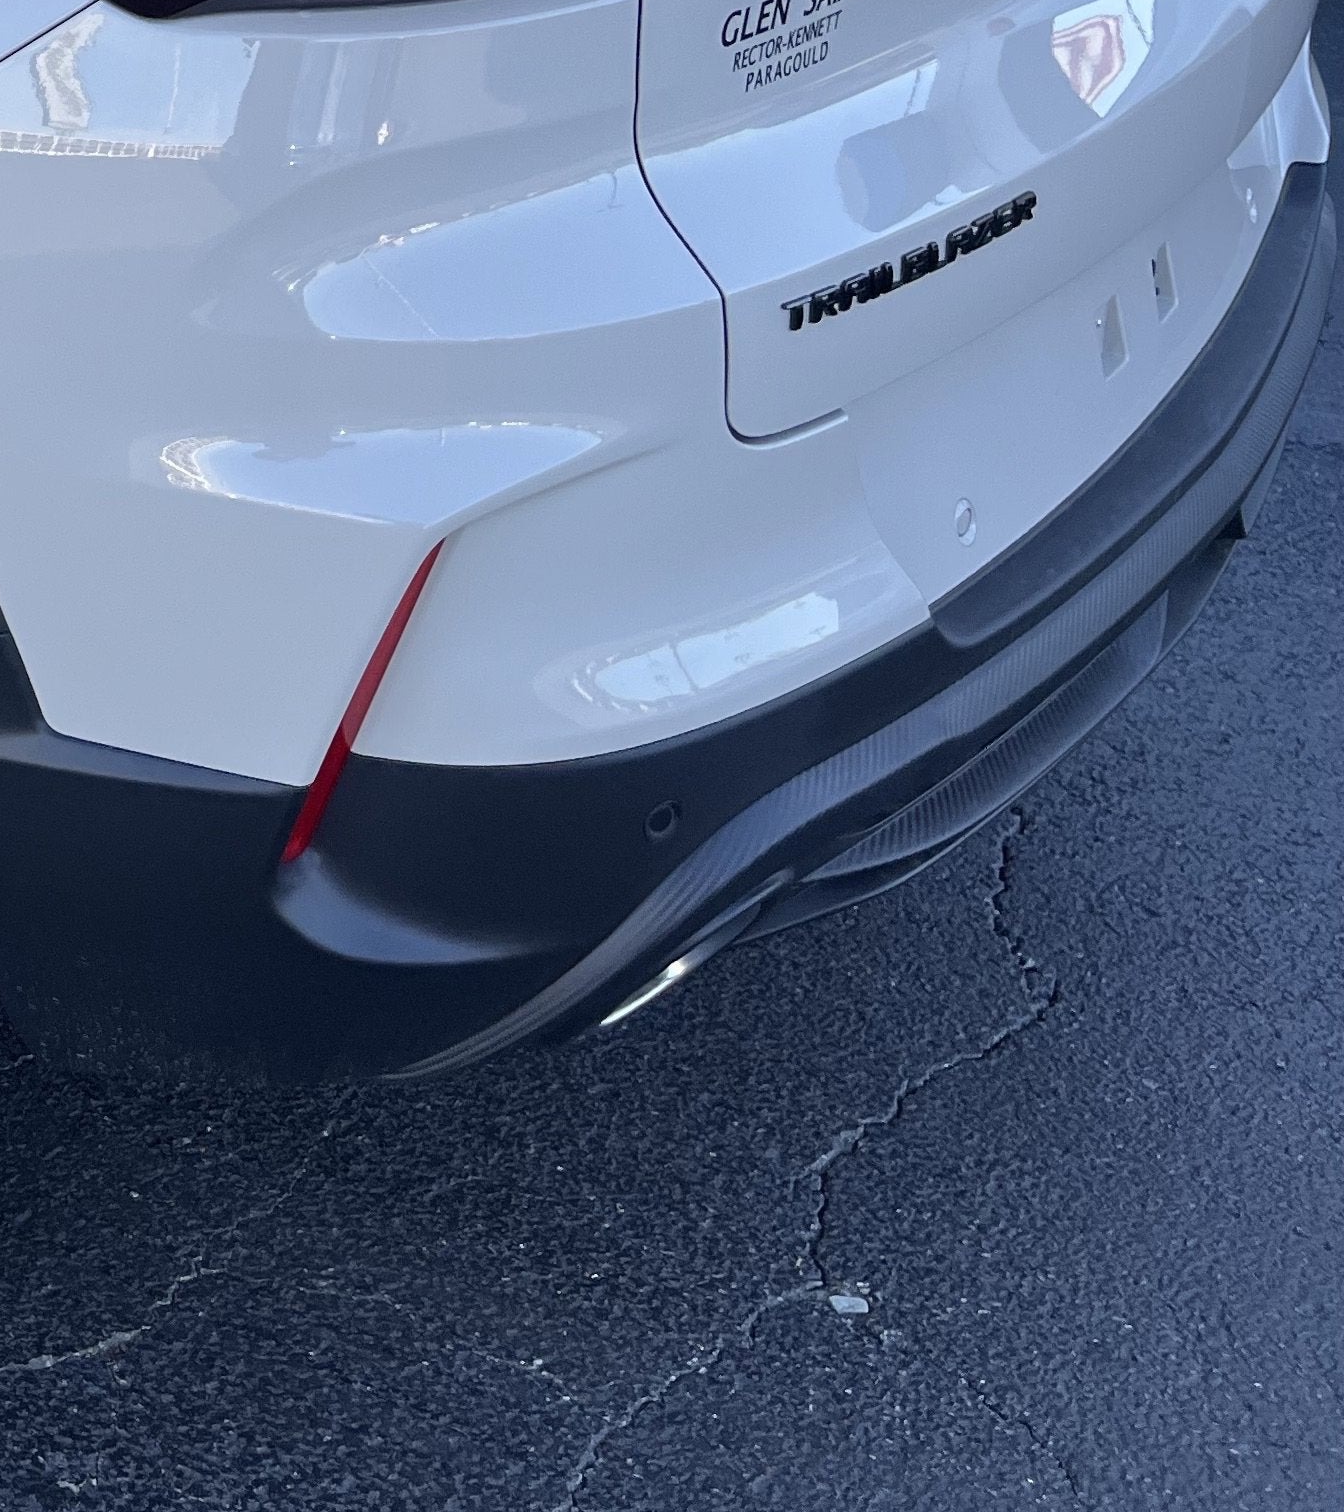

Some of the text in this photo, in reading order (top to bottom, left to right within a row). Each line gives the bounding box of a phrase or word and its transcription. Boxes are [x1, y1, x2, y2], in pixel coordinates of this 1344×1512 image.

[732, 9, 843, 72] RECTOR-KENNETT
[744, 40, 829, 93] PARAGOULD
[780, 190, 1038, 331] TRAILBLAZER
